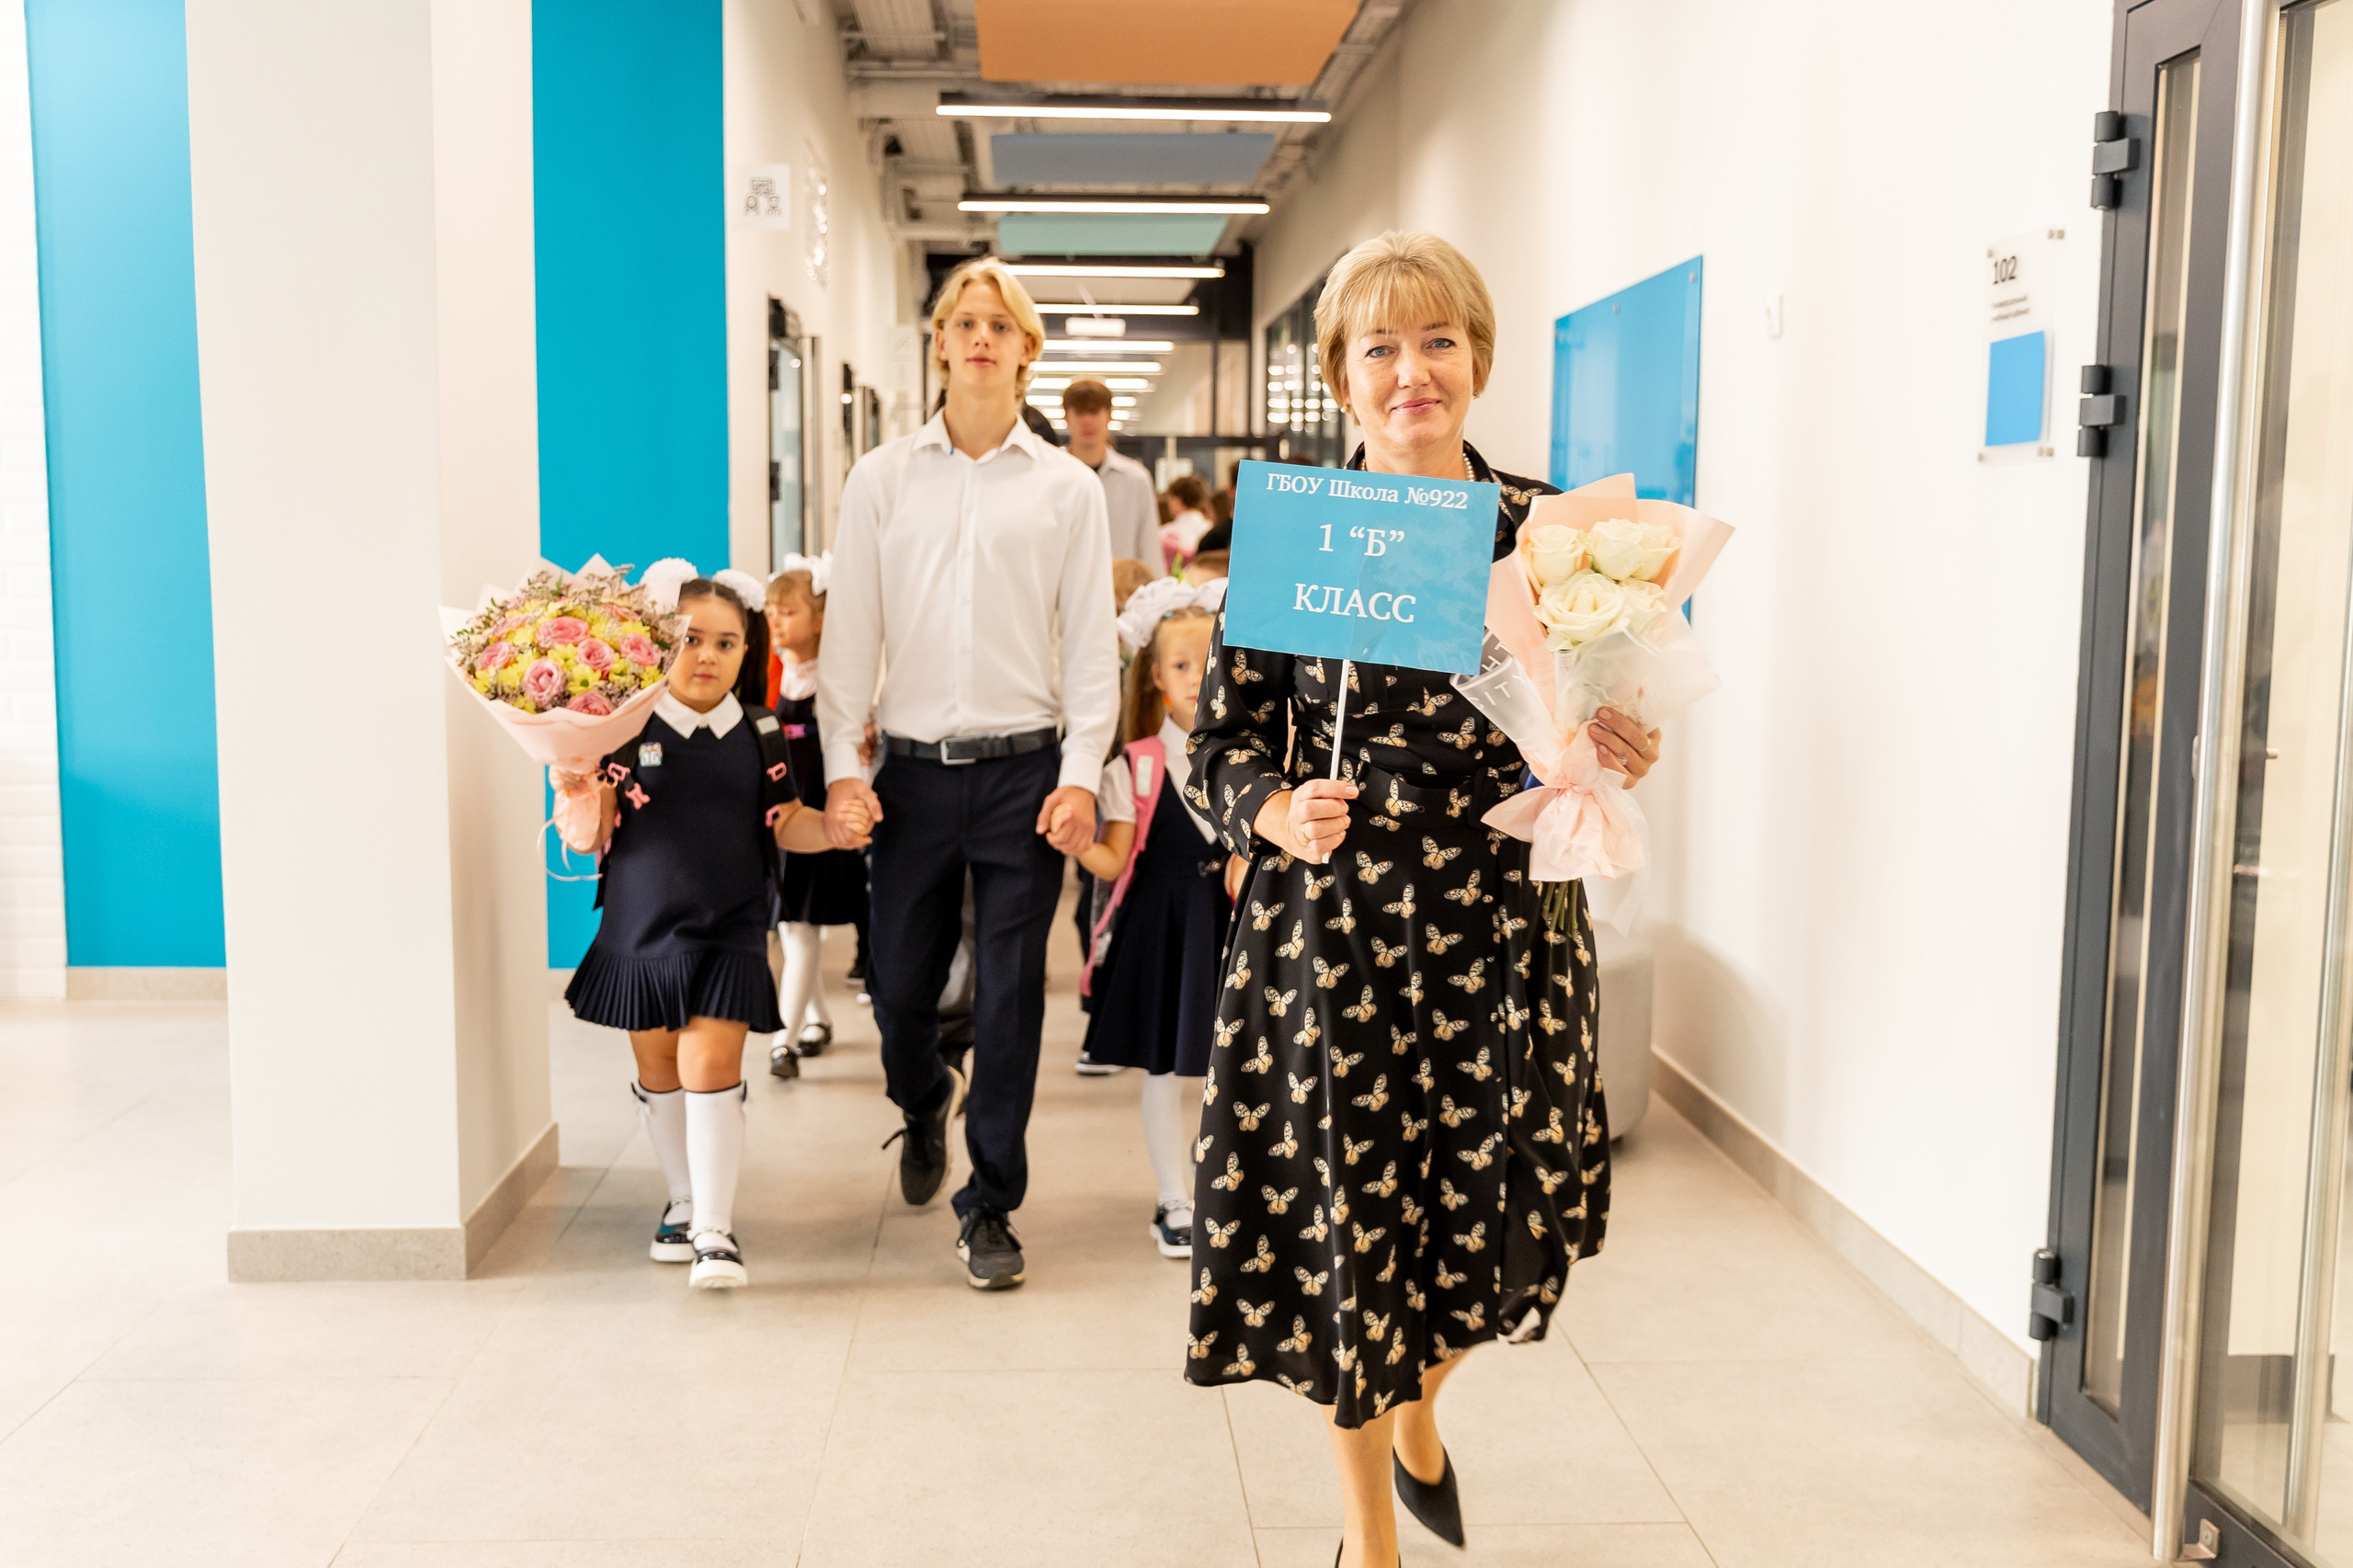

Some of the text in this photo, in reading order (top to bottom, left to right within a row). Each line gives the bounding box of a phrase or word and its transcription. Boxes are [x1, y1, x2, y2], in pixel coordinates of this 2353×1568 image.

[1993, 256, 2018, 285] 102
[1267, 473, 1468, 509] ГБОУ Школа №922
[1320, 524, 1333, 551] 1
[1293, 584, 1415, 622] КЛАСС
